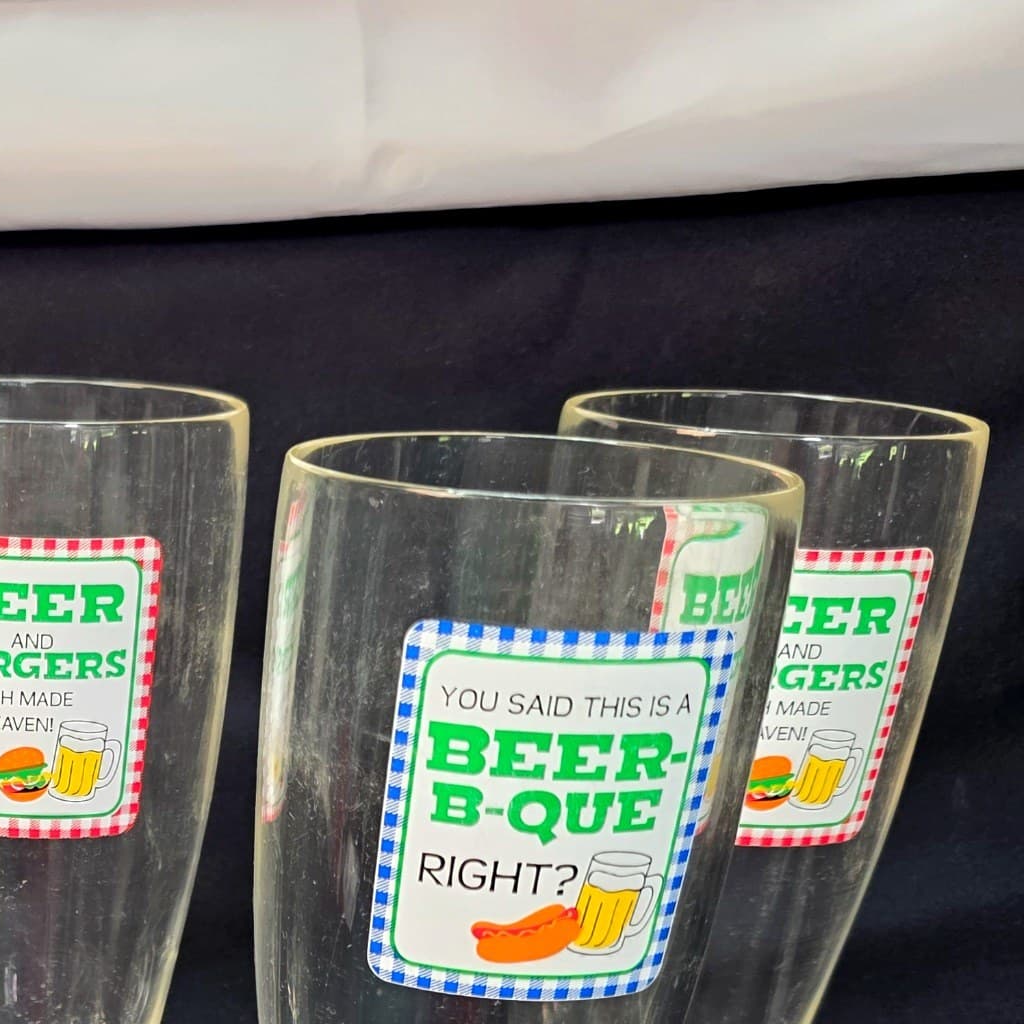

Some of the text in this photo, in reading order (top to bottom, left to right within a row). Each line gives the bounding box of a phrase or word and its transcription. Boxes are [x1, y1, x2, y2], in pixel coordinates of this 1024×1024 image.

[10, 632, 55, 650] AND
[778, 643, 823, 660] AND
[772, 660, 888, 691] GERS
[19, 690, 75, 707] MADE
[440, 685, 692, 719] YOU SAID THIS IS A
[775, 700, 833, 716] MADE
[760, 726, 808, 741] VEN!
[426, 720, 688, 782] BEER-
[430, 781, 664, 846] B-QUE
[417, 851, 578, 897] RIGHT?
